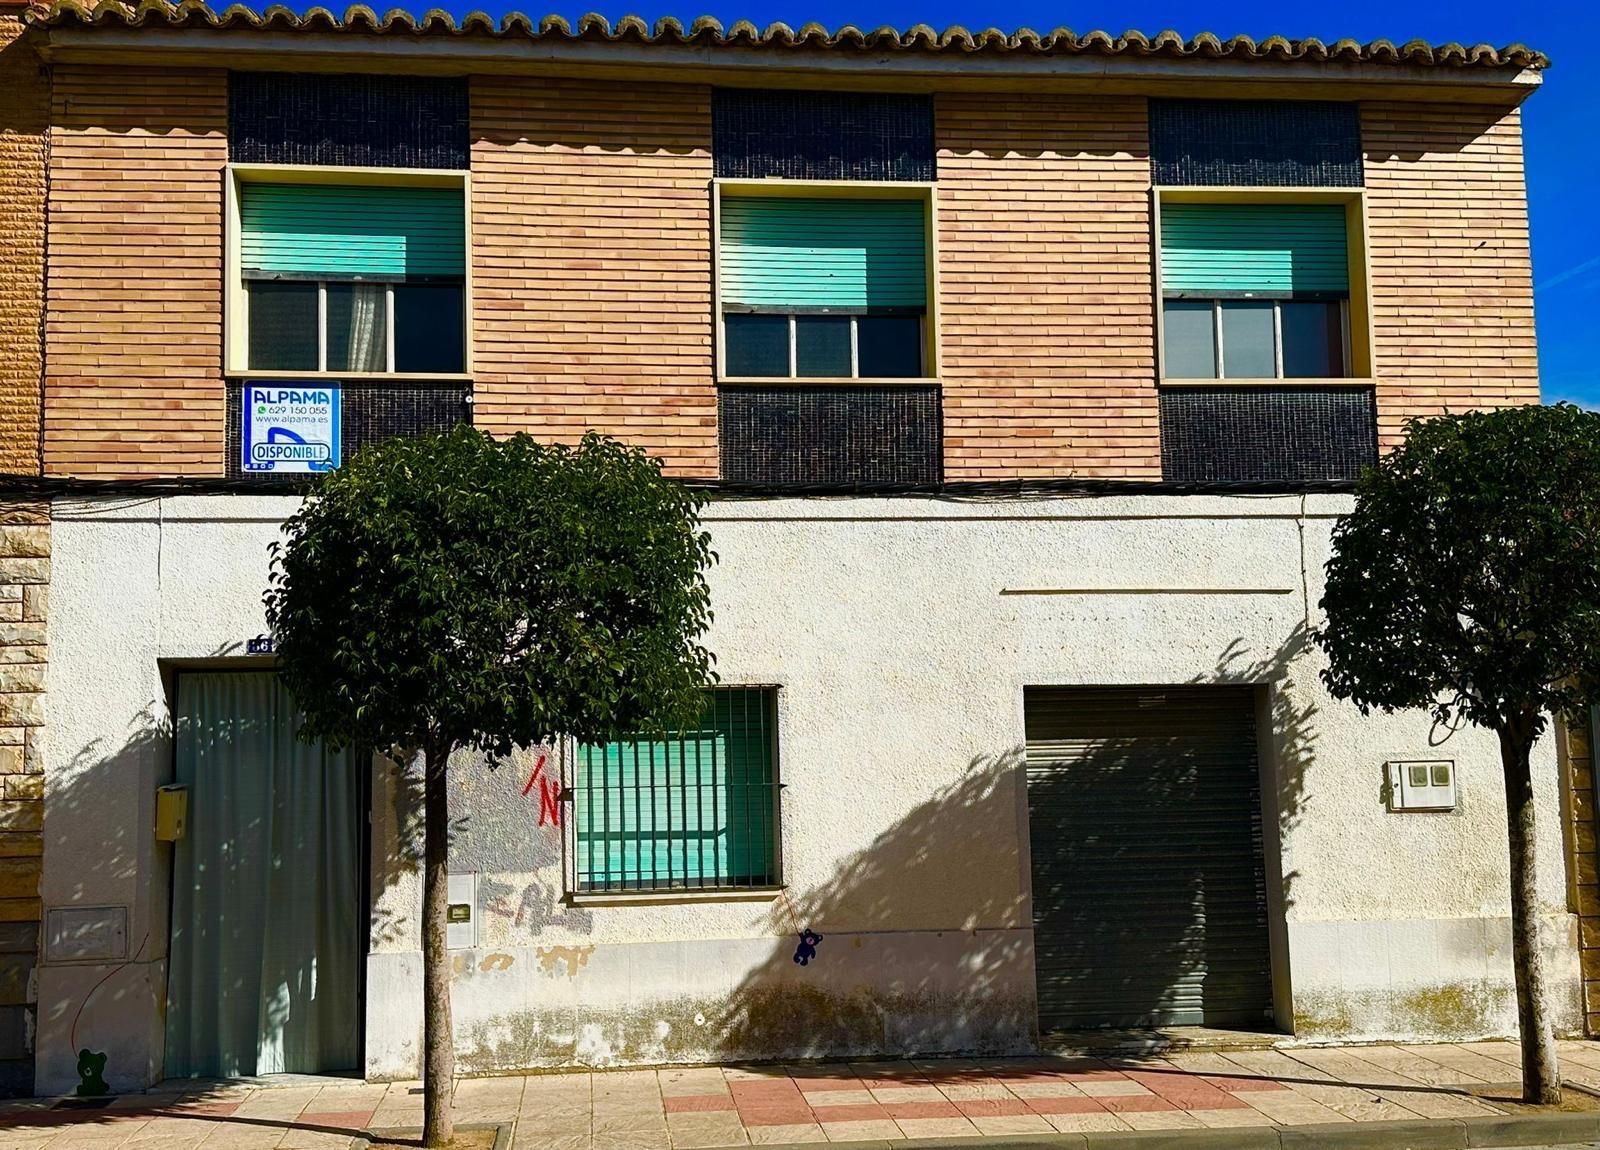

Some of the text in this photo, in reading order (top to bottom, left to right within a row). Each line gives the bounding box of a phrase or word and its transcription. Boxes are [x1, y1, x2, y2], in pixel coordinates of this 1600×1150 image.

[254, 390, 330, 404] ALPAMA
[268, 406, 328, 415] 629 150 055
[255, 415, 329, 424] www.alpama.es
[257, 446, 325, 459] DISPONIBLE
